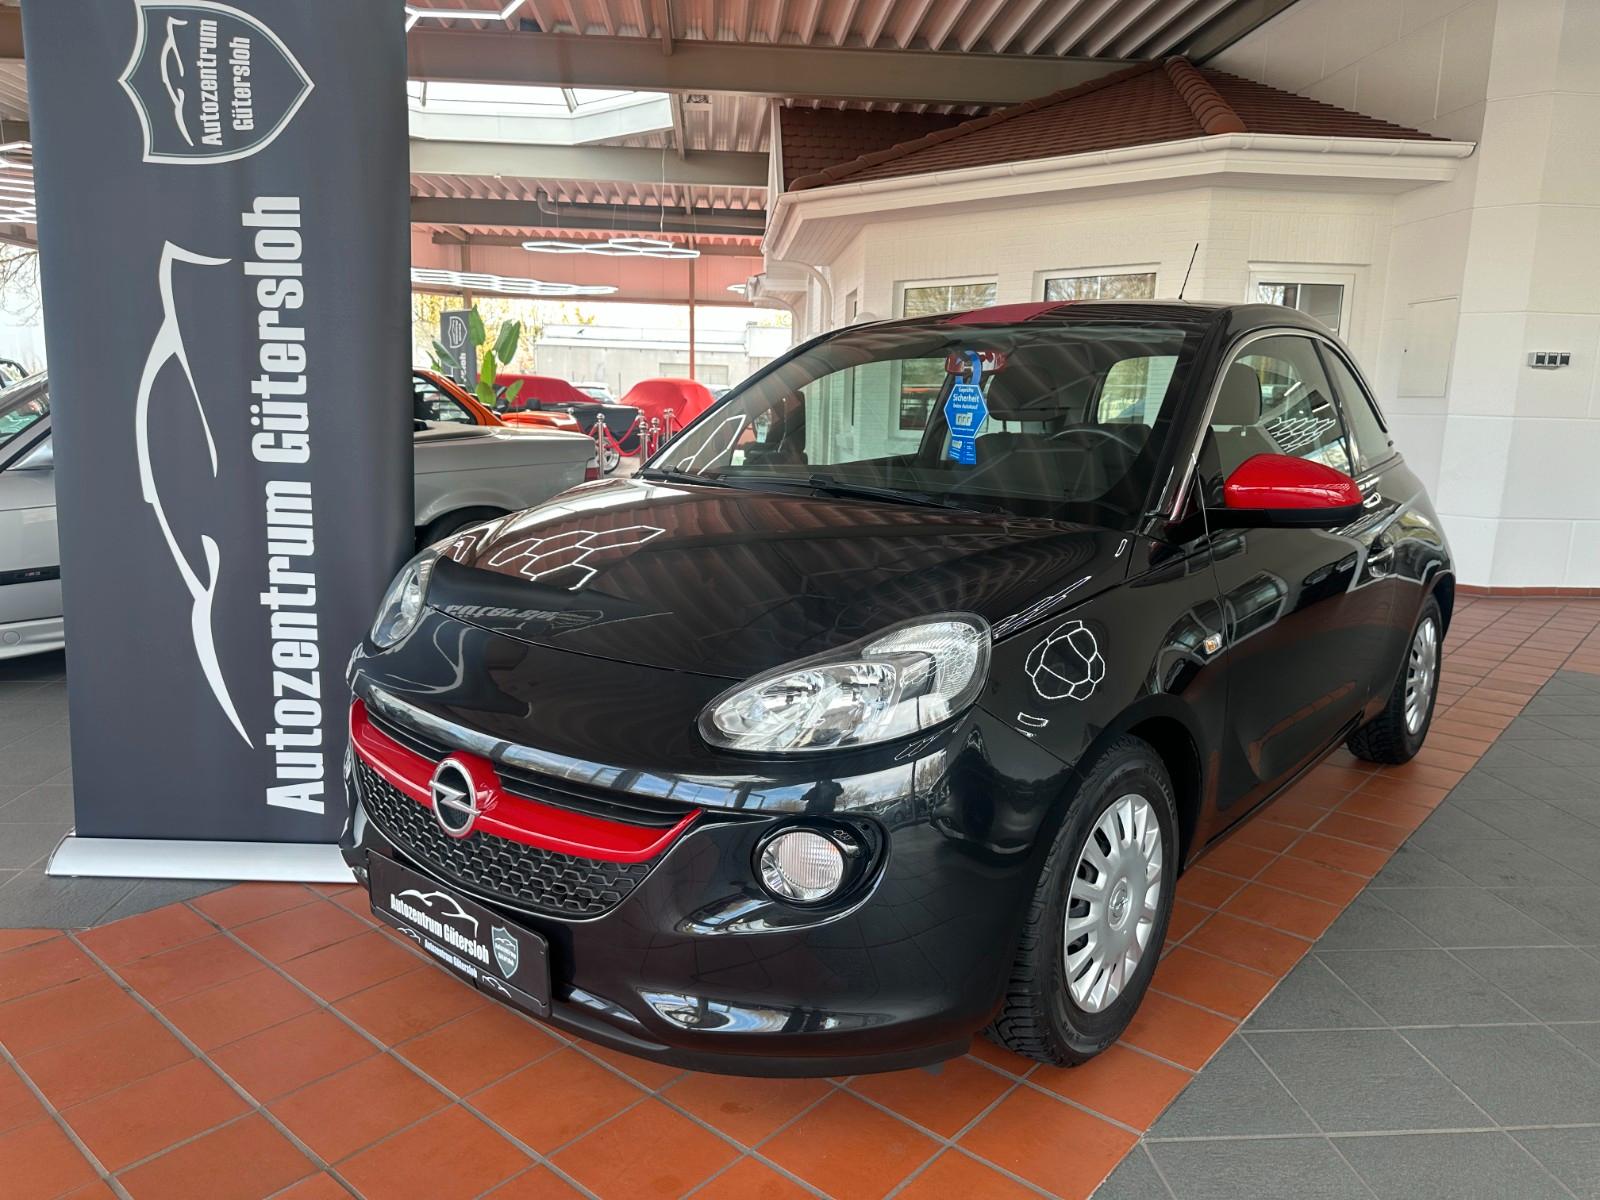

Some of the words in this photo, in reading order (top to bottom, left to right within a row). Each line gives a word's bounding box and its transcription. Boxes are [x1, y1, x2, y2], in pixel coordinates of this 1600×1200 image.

[196, 19, 223, 146] Autozentrum
[228, 36, 254, 131] Gütersloh
[241, 196, 310, 464] Gütersloh
[953, 393, 979, 402] Sicherheit
[259, 480, 326, 815] Autozentrum
[390, 893, 442, 938] Autozentrum
[443, 923, 489, 965] Gütersloh
